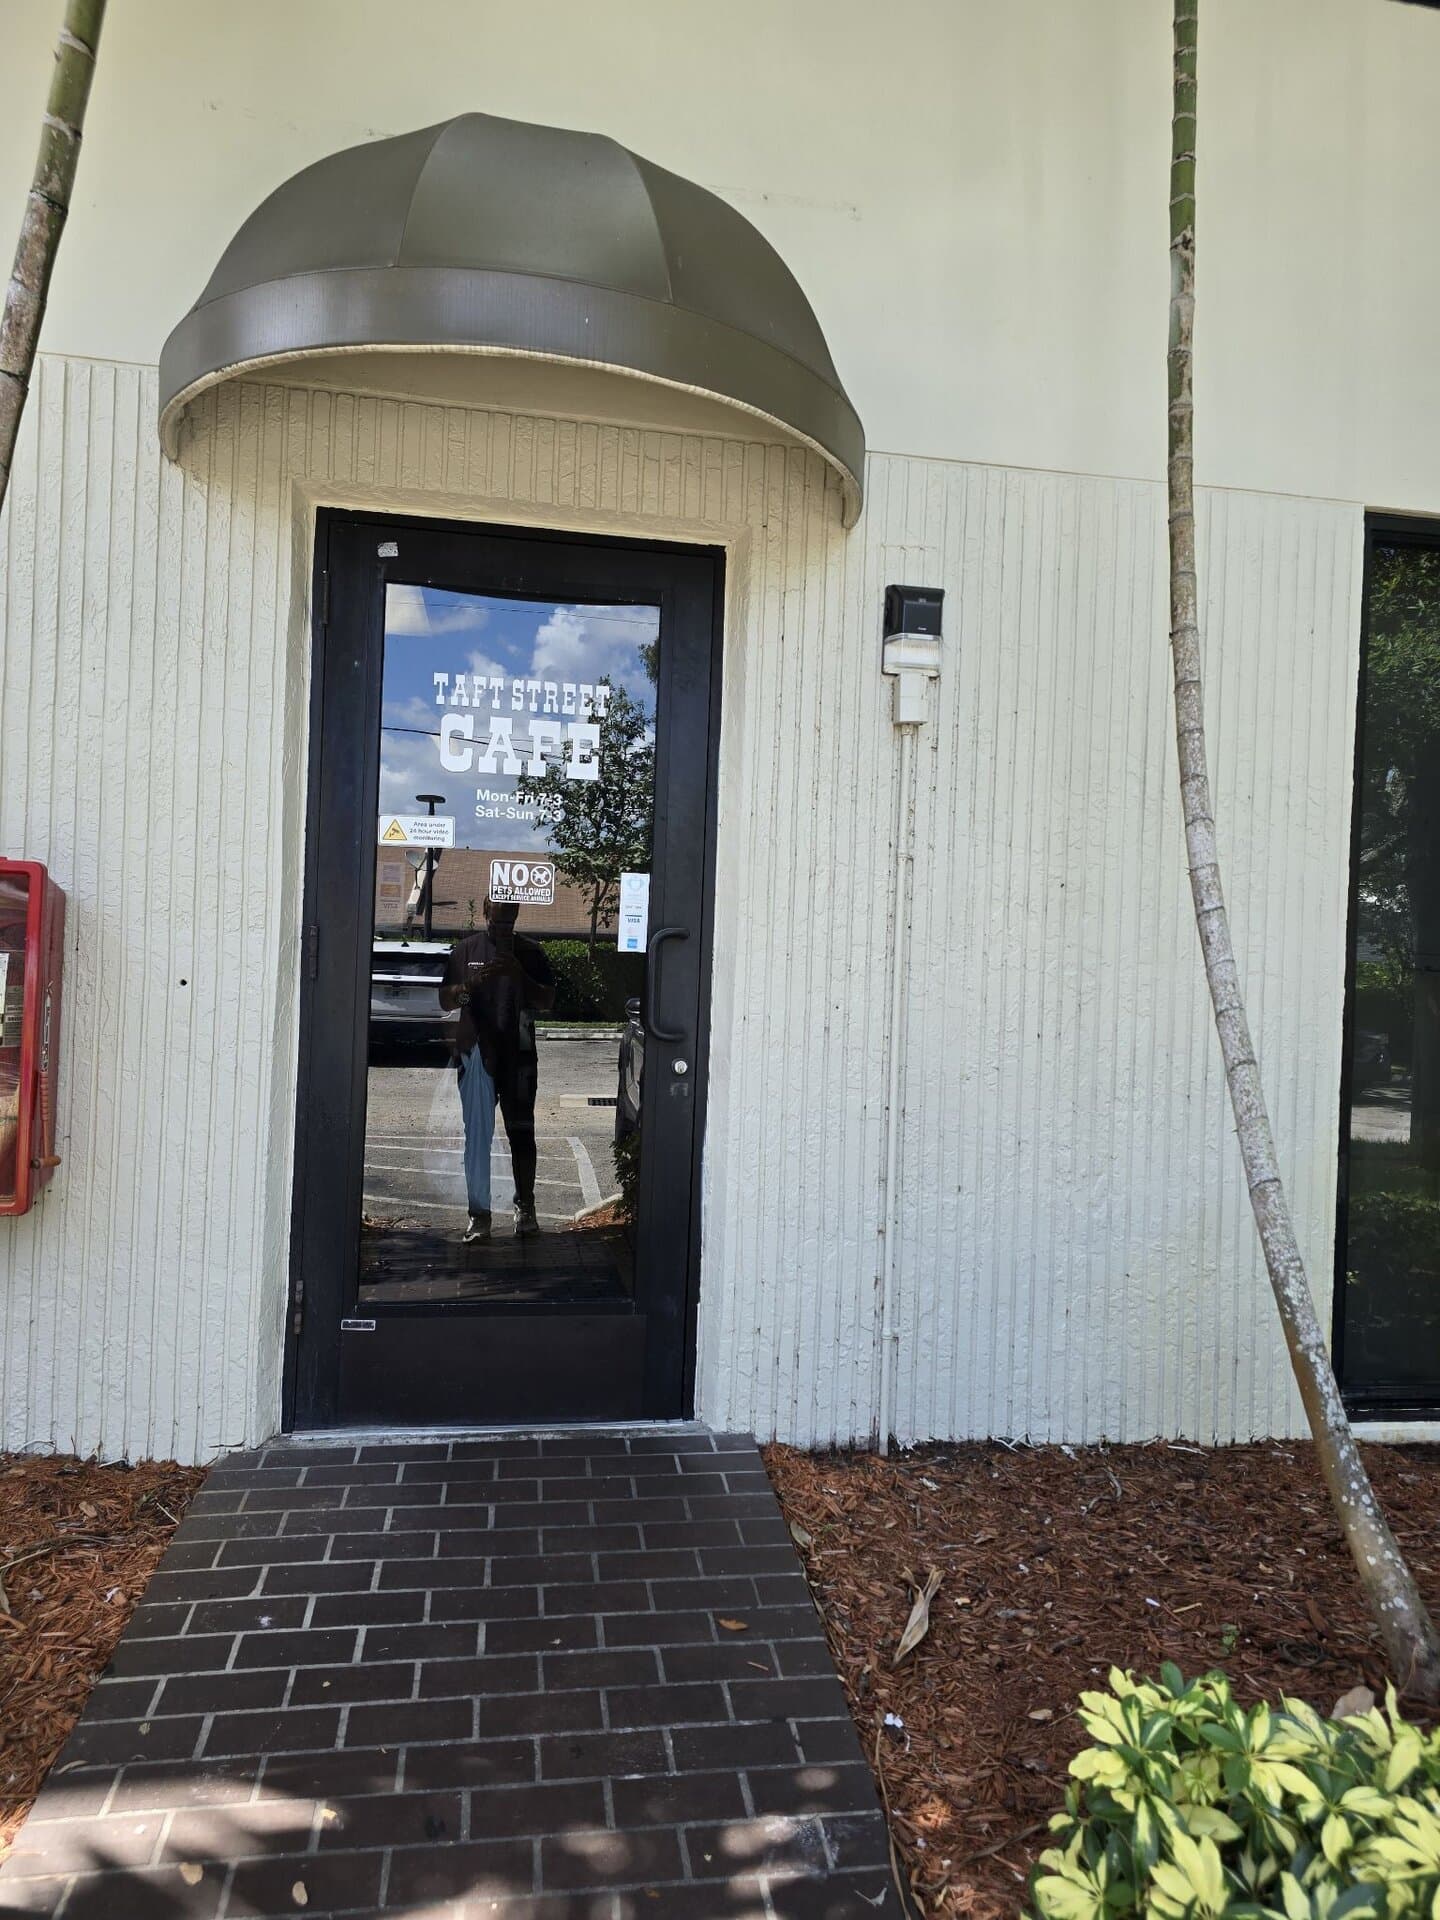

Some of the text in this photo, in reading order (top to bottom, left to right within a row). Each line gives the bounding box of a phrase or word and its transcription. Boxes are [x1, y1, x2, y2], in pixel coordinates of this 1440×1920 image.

[433, 672, 610, 716] TAFT STREET
[440, 713, 600, 780] CAFE
[476, 789, 563, 806] Mon-Fri 7-3
[475, 805, 562, 822] Sat-Sun 7-3
[493, 862, 529, 886] NO
[493, 885, 551, 897] PETS ALLOWED
